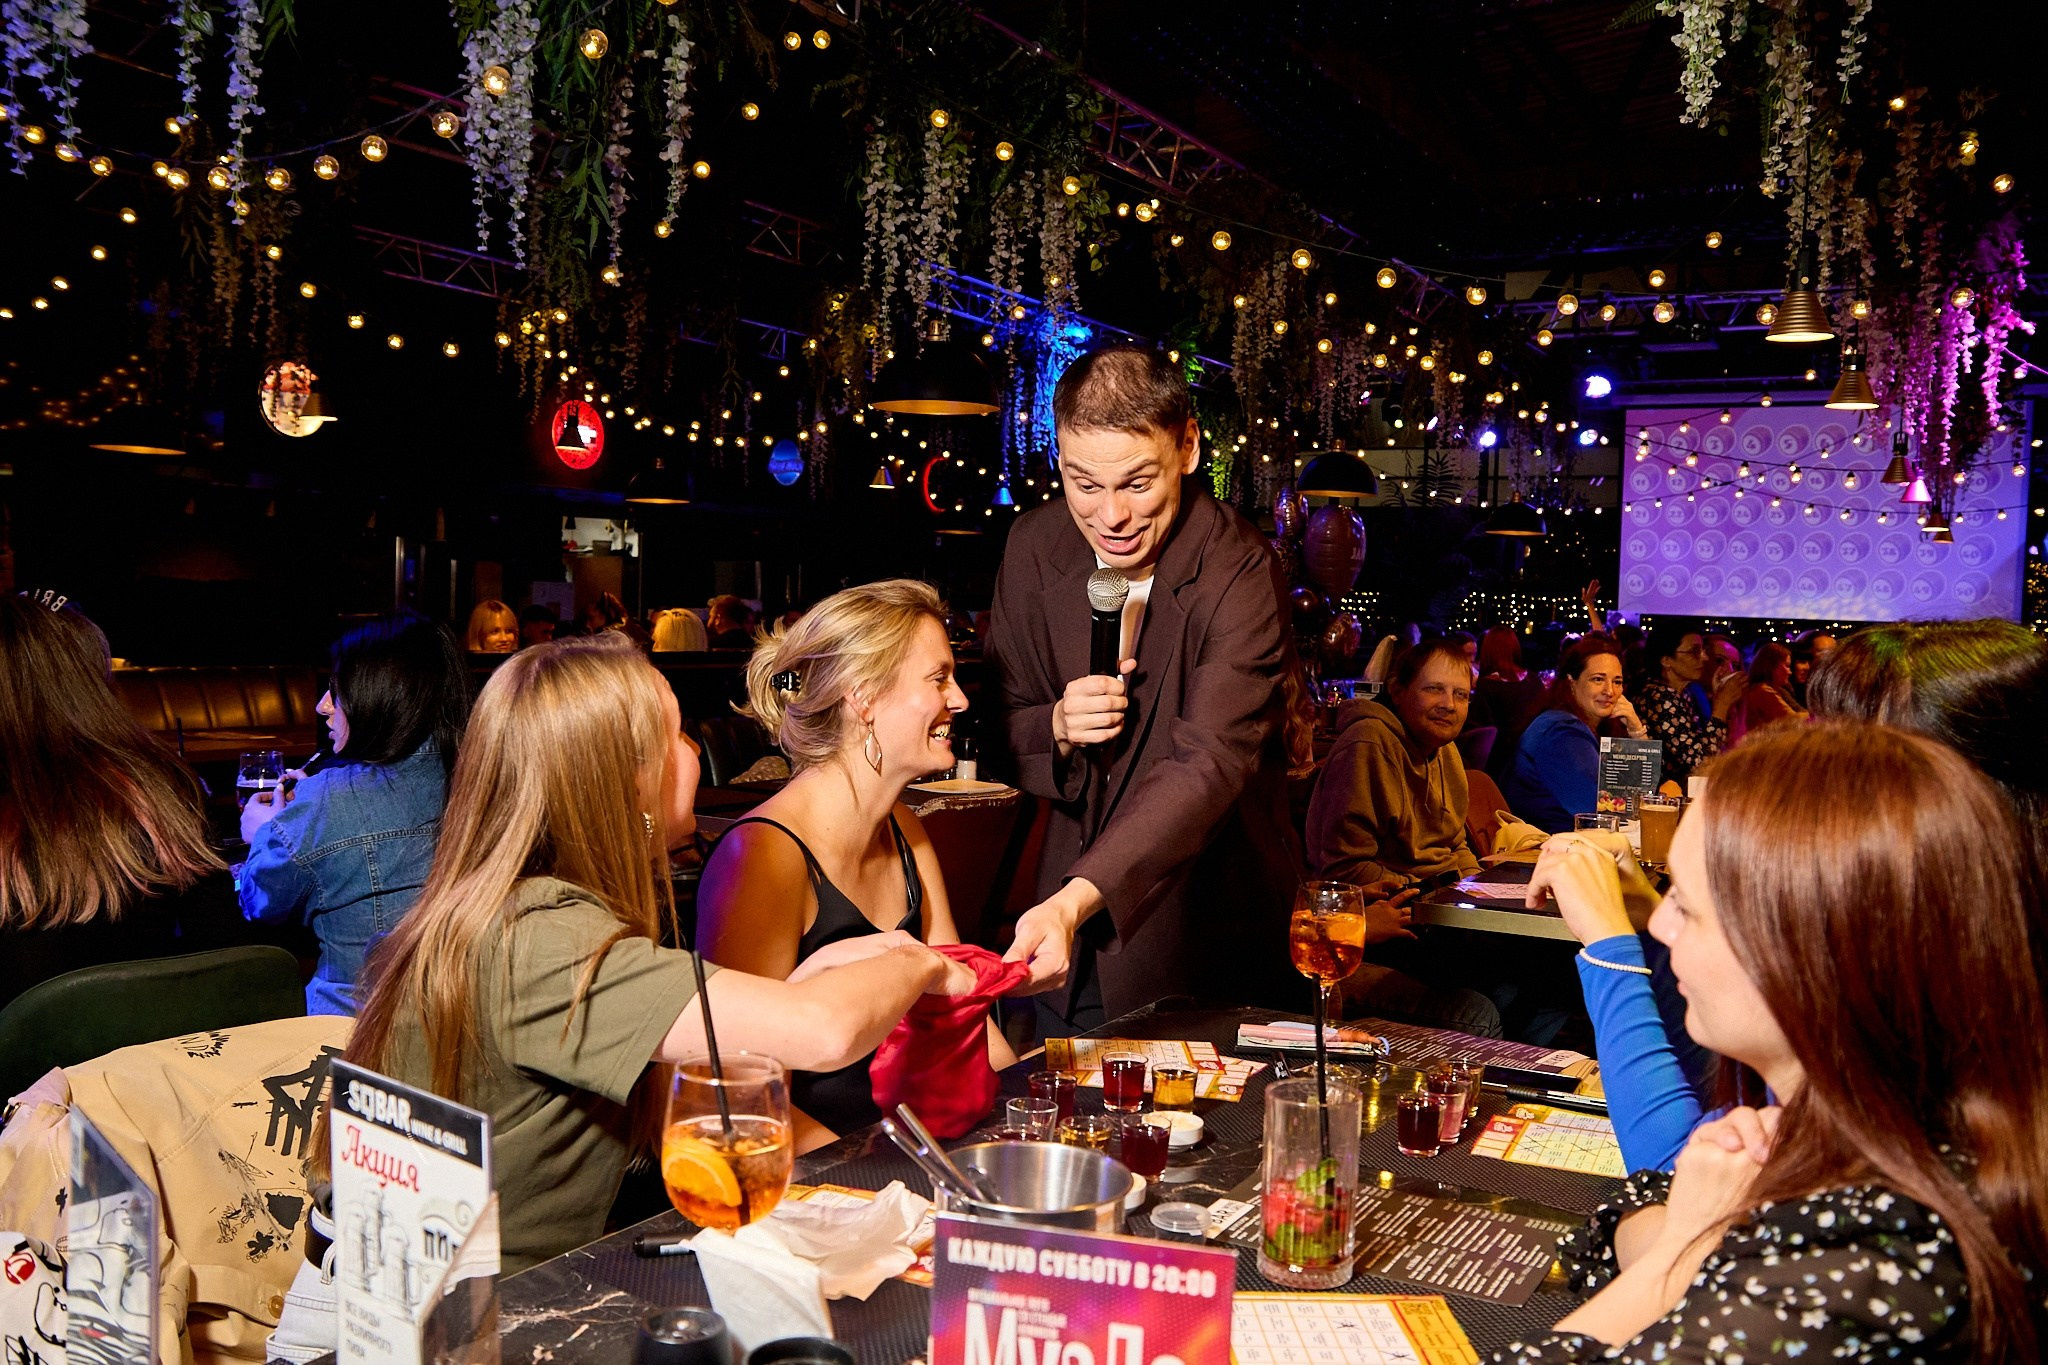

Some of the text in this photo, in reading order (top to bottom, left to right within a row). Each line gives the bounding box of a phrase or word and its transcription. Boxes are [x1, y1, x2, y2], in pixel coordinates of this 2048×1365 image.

[1709, 439, 1719, 450] 3
[1746, 439, 1756, 449] 4
[1783, 439, 1793, 450] 5
[1842, 547, 1857, 556] 37
[1919, 549, 1935, 558] 39
[410, 1117, 435, 1143] WINE
[434, 1127, 442, 1146] &
[342, 1125, 420, 1193] Акция
[947, 1236, 1217, 1298] КАЖДУЮ СУББОТУ В 20:00
